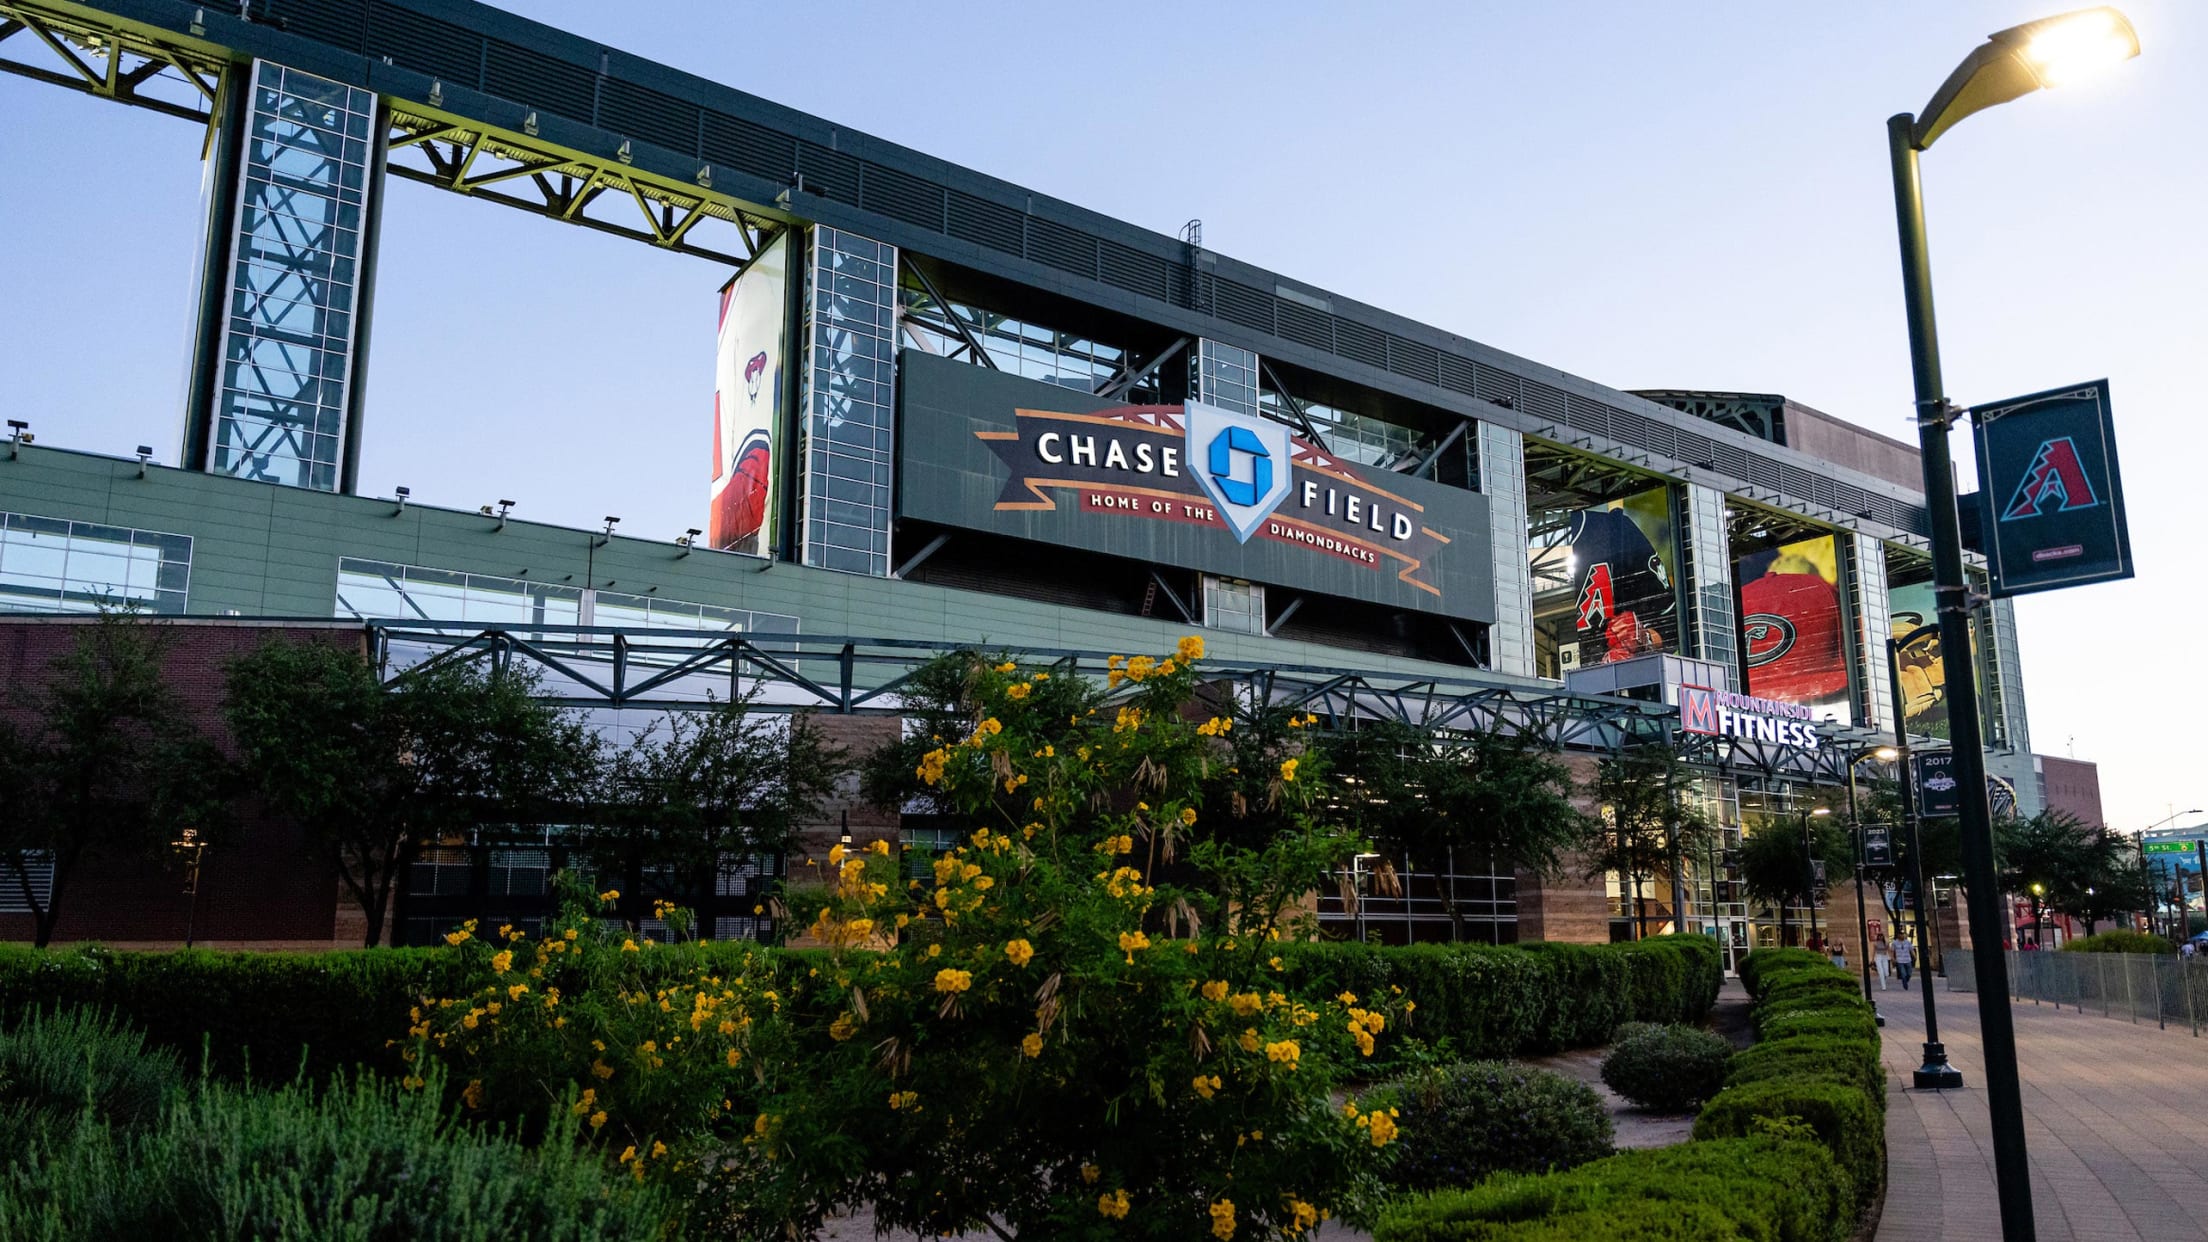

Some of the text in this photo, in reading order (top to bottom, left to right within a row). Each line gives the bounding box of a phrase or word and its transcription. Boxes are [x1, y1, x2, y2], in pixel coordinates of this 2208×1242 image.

[1037, 432, 1413, 541] CHASE FIELD
[1090, 494, 1376, 564] HOME OF THE DIAMONDBACKS
[1717, 708, 1819, 749] FITNESS
[1925, 757, 1953, 766] 2017
